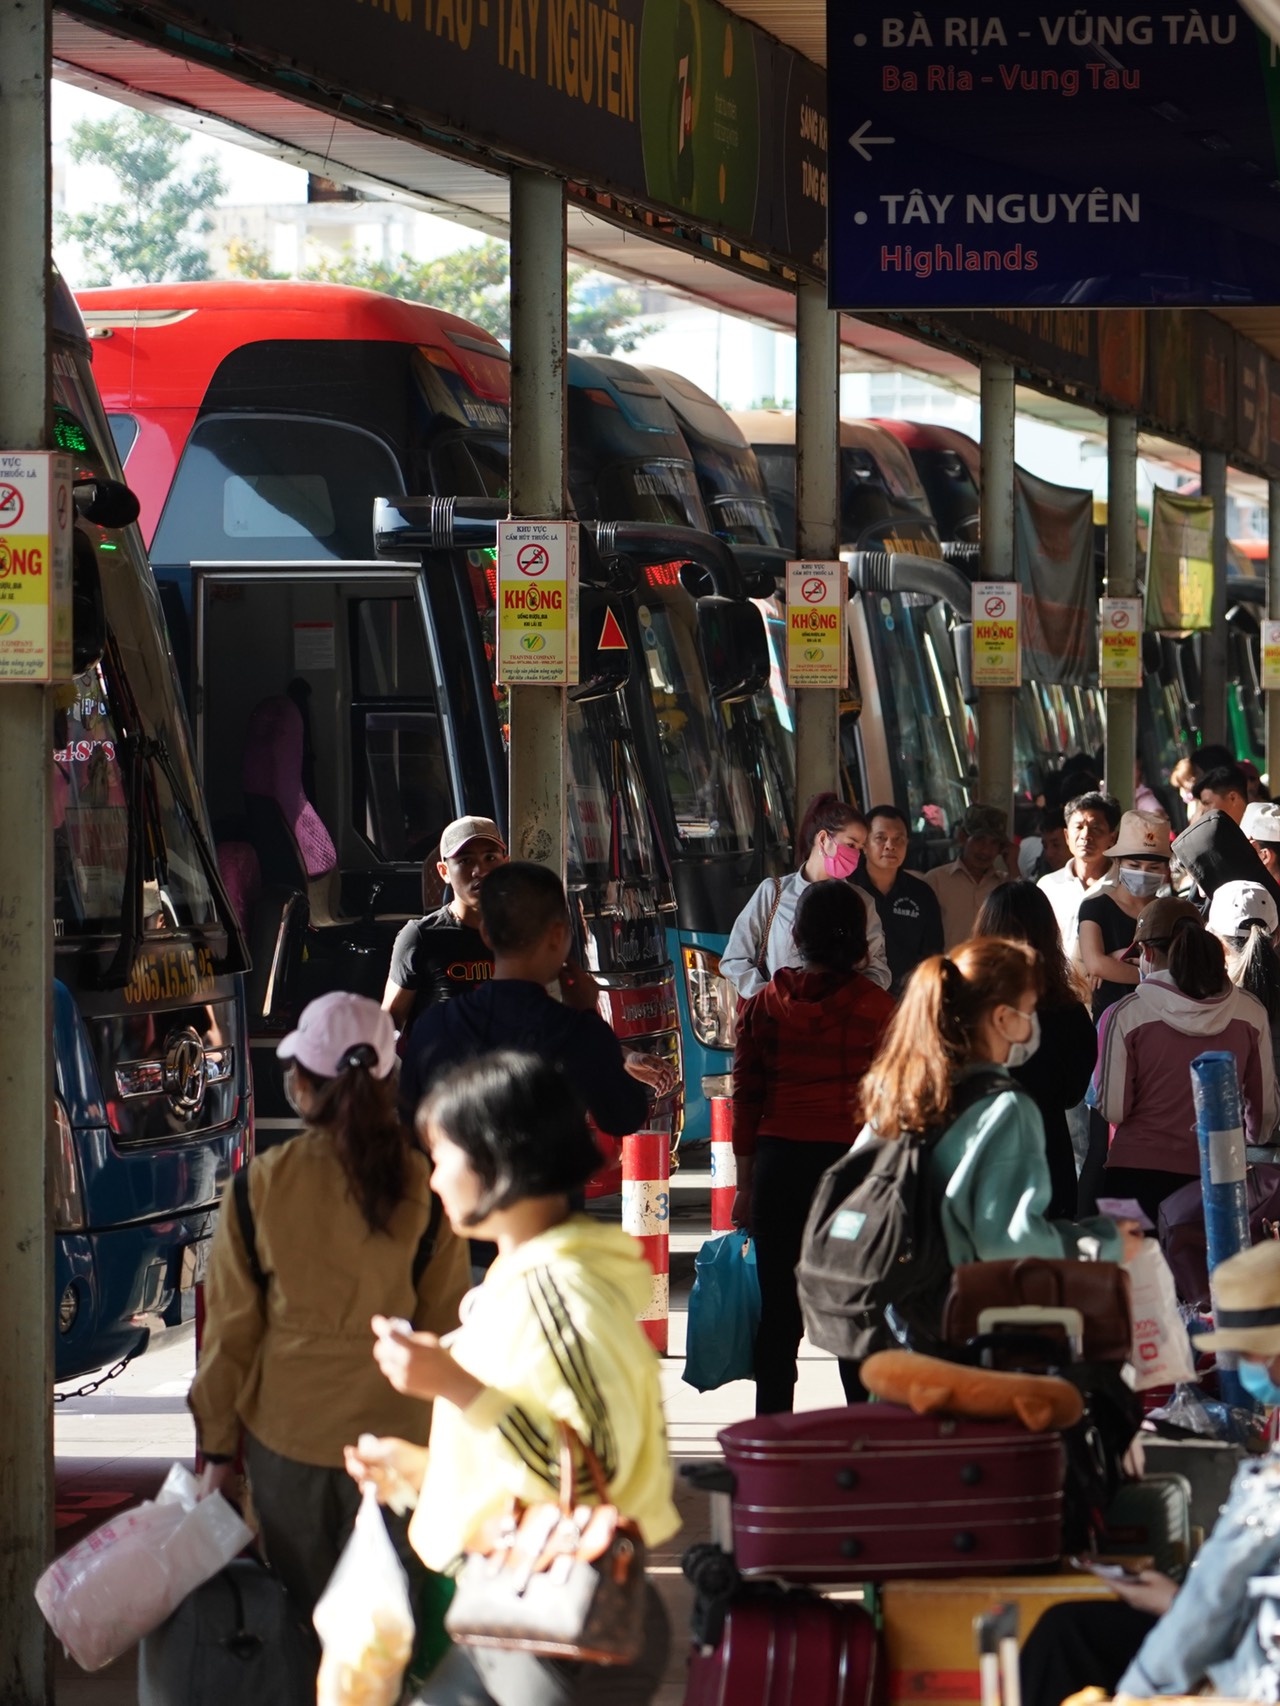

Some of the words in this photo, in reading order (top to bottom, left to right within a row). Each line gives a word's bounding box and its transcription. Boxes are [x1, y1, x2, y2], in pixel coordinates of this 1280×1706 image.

[880, 14, 937, 49] BÀ
[945, 16, 1008, 56] RỊA
[1038, 13, 1154, 47] VŨNG
[1162, 12, 1239, 46] TÀU
[881, 65, 918, 93] Ba
[926, 64, 974, 93] Ria
[999, 66, 1079, 98] Vung
[1084, 63, 1142, 92] Tau
[879, 185, 953, 225] TÂY
[965, 185, 1142, 226] NGUYÊN
[879, 243, 1039, 278] Highlands
[1, 457, 21, 468] VỰC
[516, 525, 532, 533] KHU
[533, 524, 548, 534] VỰC
[504, 581, 562, 612] KHÔNG
[791, 608, 837, 631] KHÔNG
[976, 622, 1014, 640] KHÔNG
